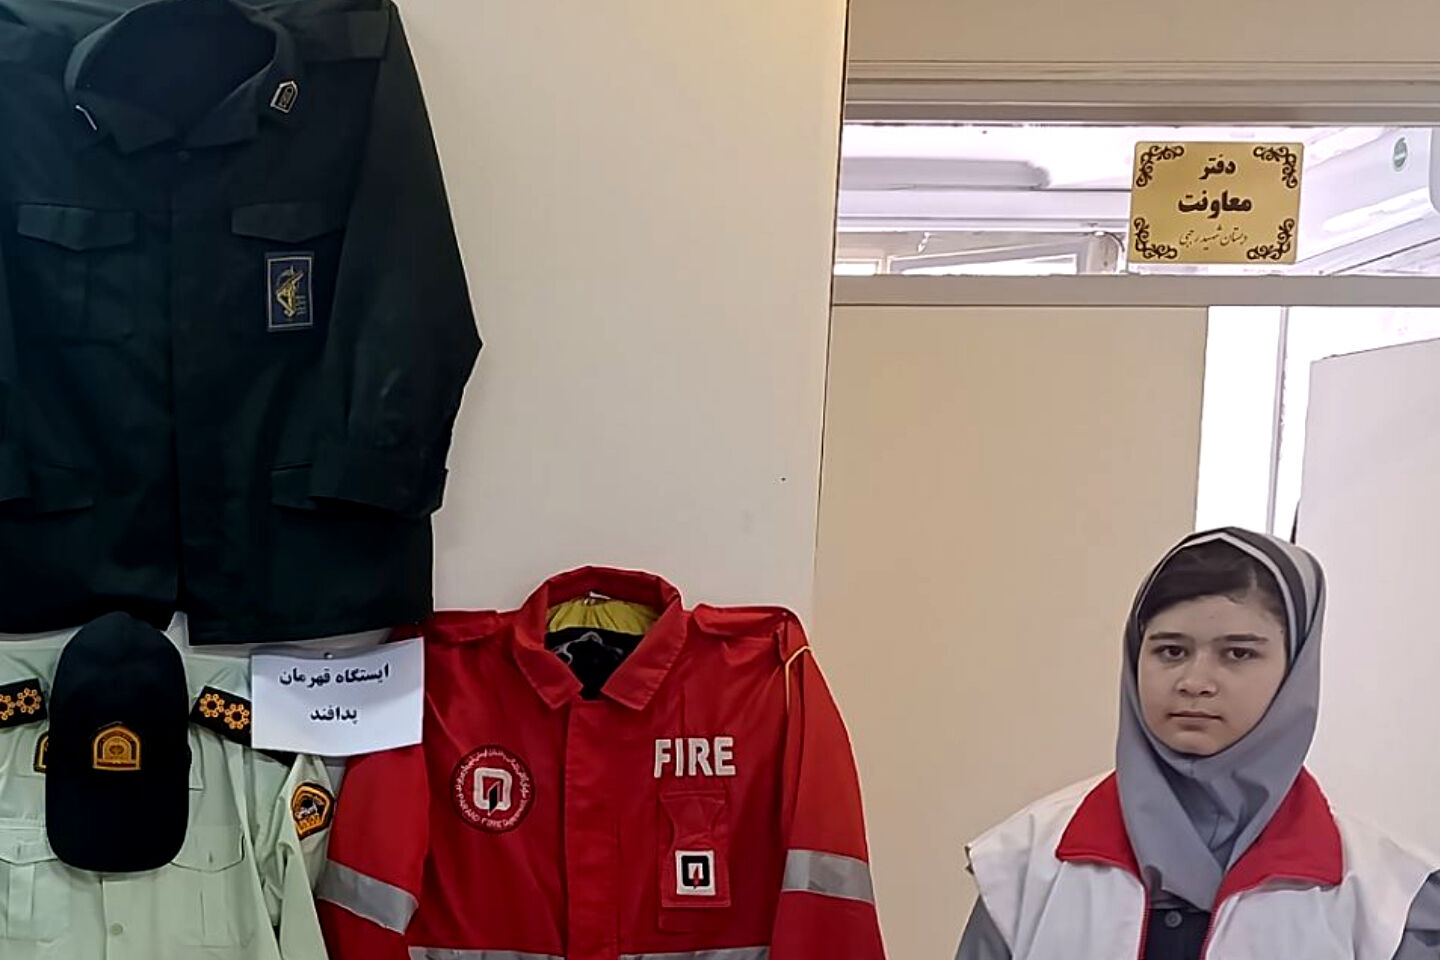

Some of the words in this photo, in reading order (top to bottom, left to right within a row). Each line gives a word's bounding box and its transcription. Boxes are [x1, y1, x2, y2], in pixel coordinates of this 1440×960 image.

[1199, 154, 1236, 179] دفتر
[1178, 191, 1252, 219] معاونت
[280, 667, 330, 688] قهرمان
[335, 663, 389, 684] ایستگاه
[311, 706, 357, 724] پدافند
[654, 736, 736, 779] FIRE
